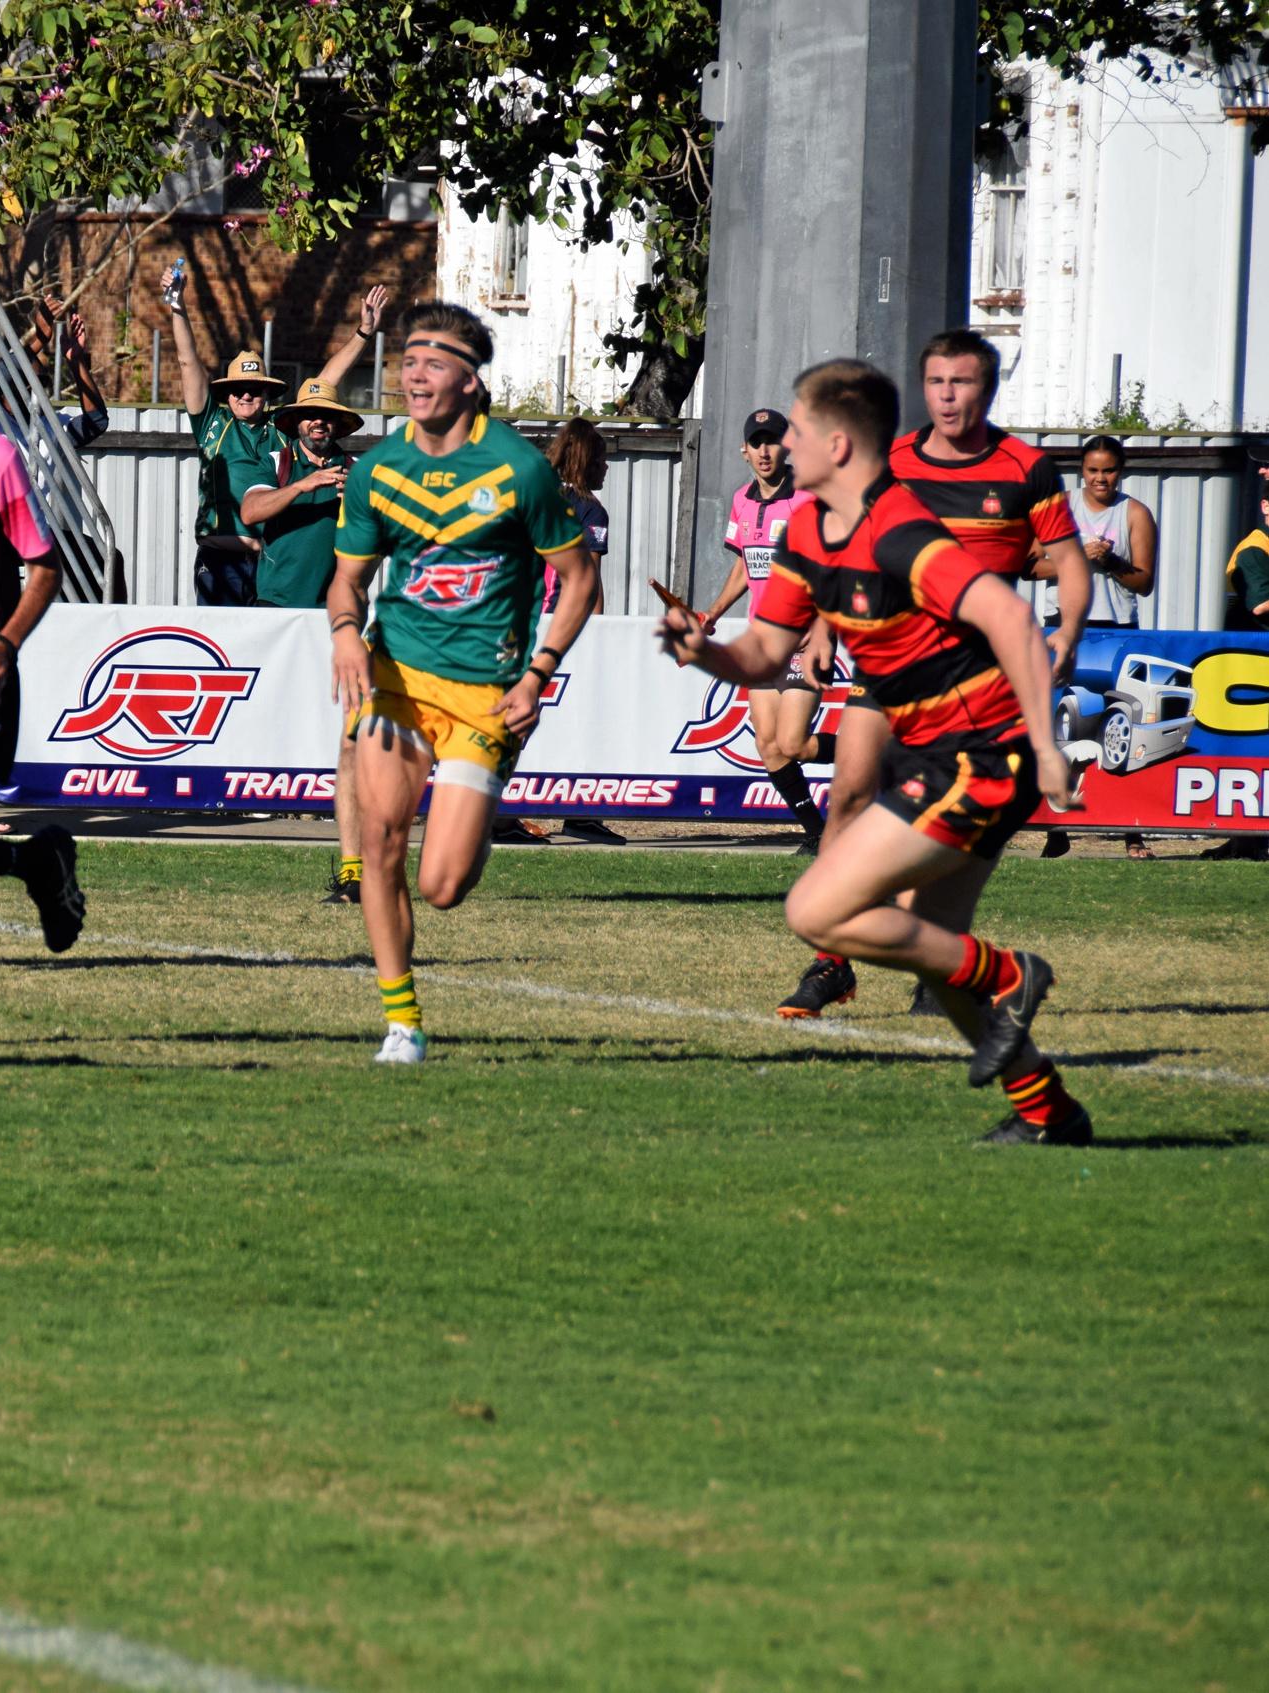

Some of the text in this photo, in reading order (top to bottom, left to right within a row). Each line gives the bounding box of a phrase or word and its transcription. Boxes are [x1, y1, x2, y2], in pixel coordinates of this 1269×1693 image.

[421, 471, 457, 489] ISC
[51, 667, 257, 741] JRT
[61, 769, 149, 796] CIVIL
[502, 777, 679, 807] QUARRIES
